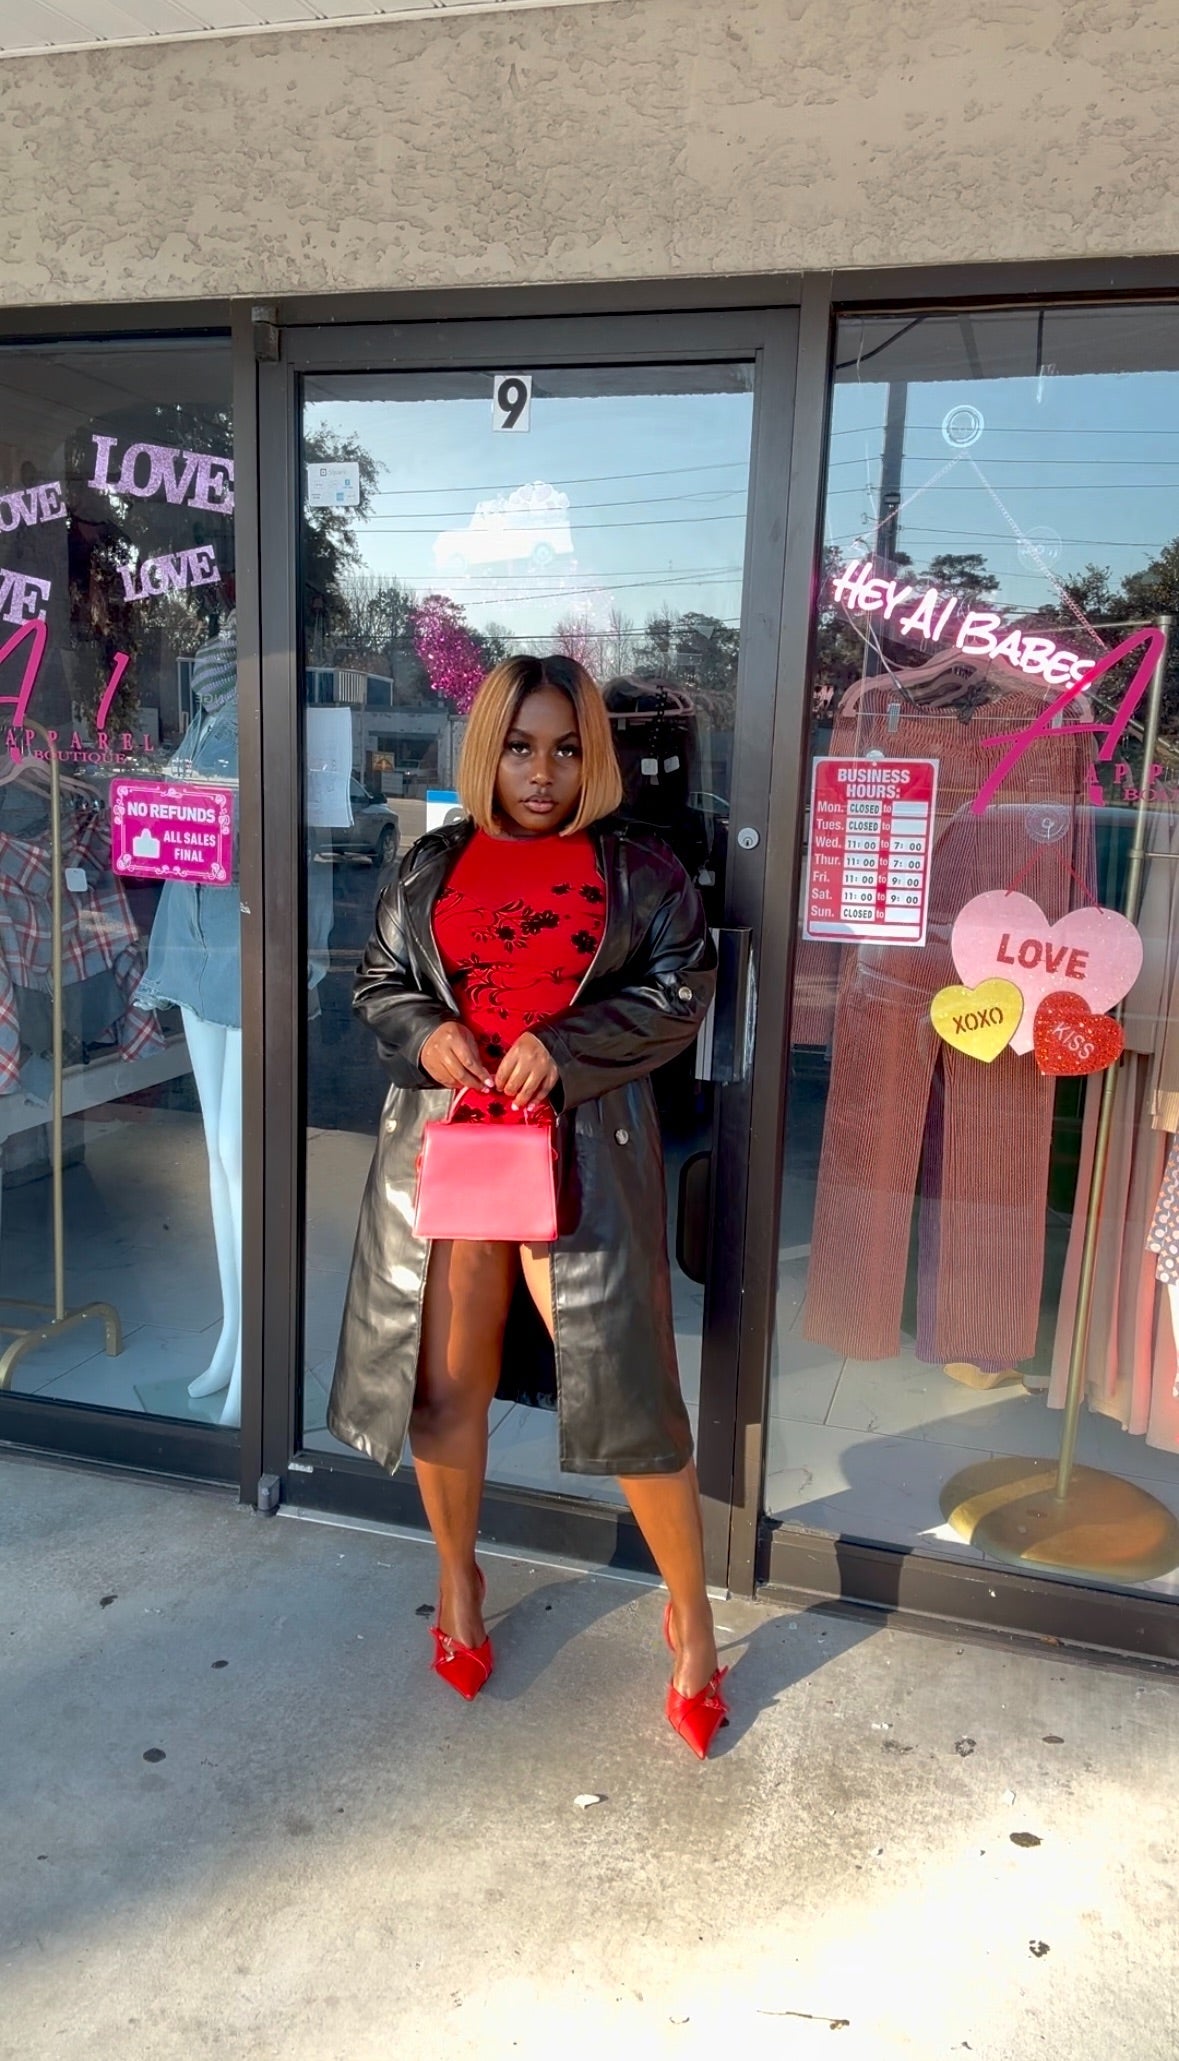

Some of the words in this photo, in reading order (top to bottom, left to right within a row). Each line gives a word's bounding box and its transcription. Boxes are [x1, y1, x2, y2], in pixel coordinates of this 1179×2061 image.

[497, 378, 528, 429] 9
[88, 434, 235, 515] LOVE
[0, 481, 68, 533] OVE
[116, 545, 222, 602] LOVE
[832, 559, 913, 620] HEY
[955, 611, 1096, 692] BABES
[6, 728, 155, 752] APPAREL
[34, 749, 127, 764] BOUTIQUE
[837, 768, 911, 784] BUSINESS
[846, 784, 901, 799] HOURS:
[127, 801, 148, 817] NO
[150, 803, 216, 824] REFUNDS
[817, 801, 844, 813] Mon.
[849, 803, 880, 814] CLOSED
[883, 804, 892, 813] to
[816, 818, 845, 831] Tues.
[848, 821, 878, 831] CLOSED
[882, 822, 891, 831] to
[163, 830, 183, 844] ALL
[183, 832, 217, 847] SALES
[815, 836, 842, 849] Wed.
[881, 839, 889, 848] to
[174, 848, 205, 863] FINAL
[814, 853, 841, 866] Thur.
[880, 857, 888, 866] to
[813, 871, 830, 882] Fri.
[878, 875, 887, 883] to
[811, 888, 833, 900] Sat.
[877, 892, 886, 901] to
[810, 905, 835, 917] Sun.
[843, 908, 873, 919] CLOSED
[876, 909, 884, 918] to
[996, 933, 1089, 981] LOVE
[952, 1006, 1004, 1035] XOXO
[1052, 1021, 1095, 1060] KISS
